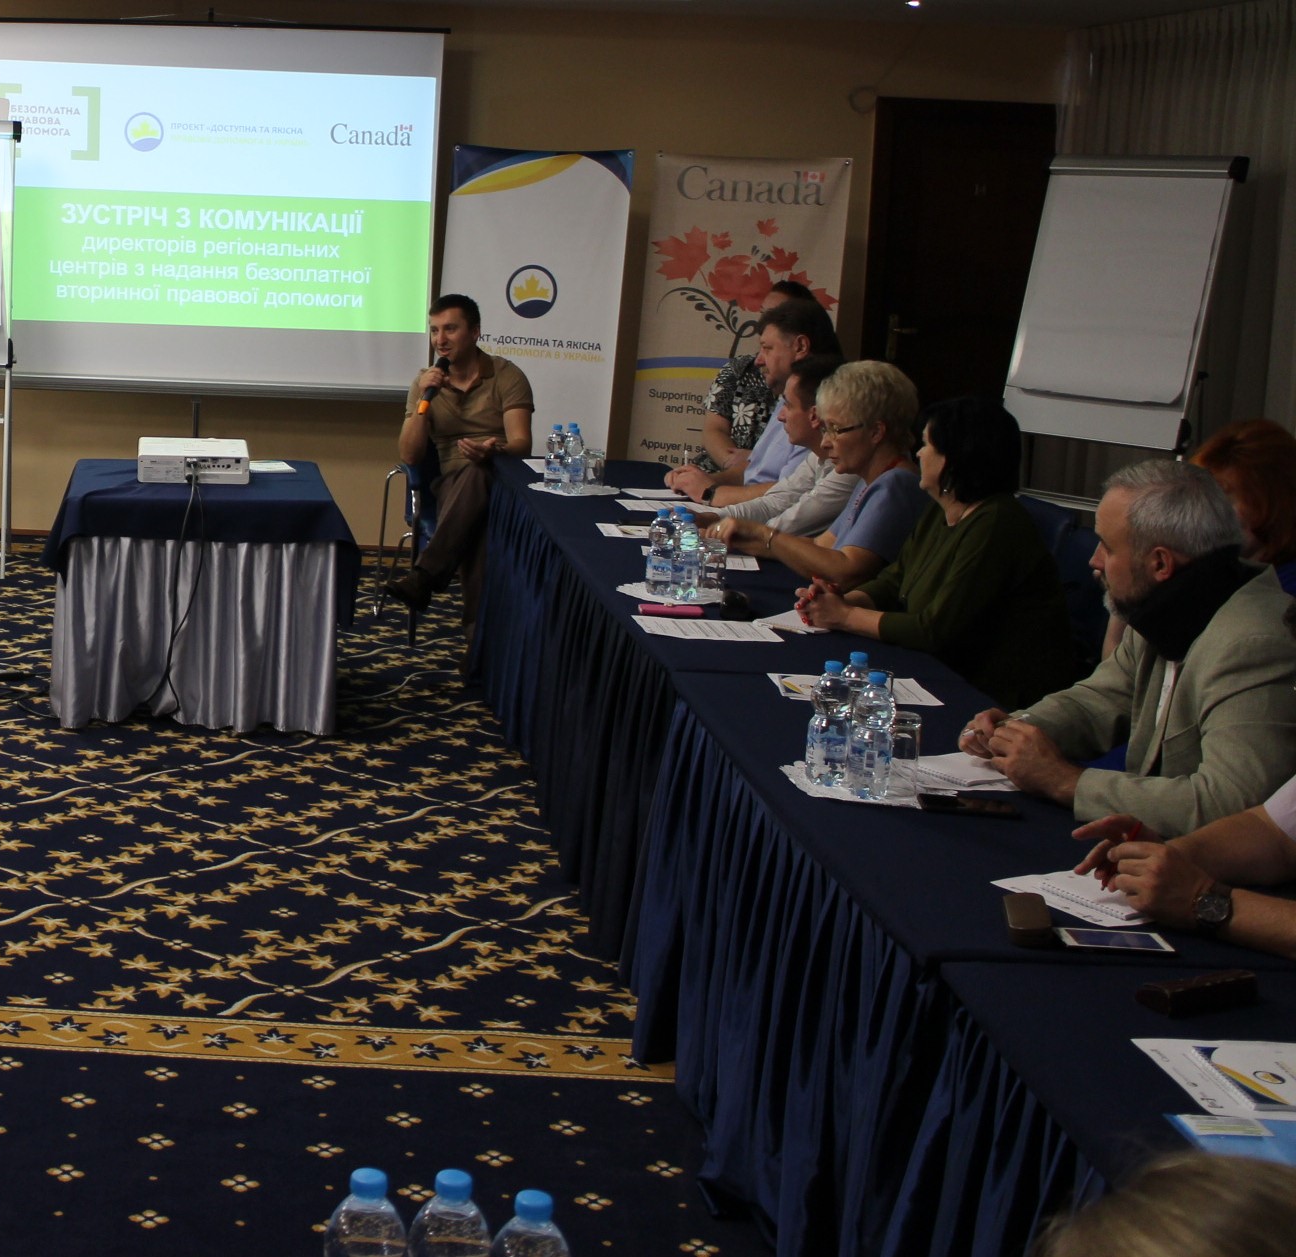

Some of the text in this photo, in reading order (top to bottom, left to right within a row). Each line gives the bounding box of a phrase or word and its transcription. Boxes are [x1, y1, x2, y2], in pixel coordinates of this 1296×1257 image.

[10, 104, 81, 116] БЕЗОПЛАТНА
[330, 123, 412, 146] Canada
[677, 165, 825, 206] Canada
[61, 202, 364, 237] ЗУСТРІЧ З КОМУНІКАЦІЇ
[81, 235, 340, 259] директорів регіональних
[49, 258, 372, 285] центрів з надання безоплатної
[56, 283, 363, 309] вторинної правової допомоги
[495, 346, 552, 359] ДОПОМОГА
[552, 339, 564, 348] ТА
[566, 340, 601, 351] ЯКІСНА
[649, 389, 703, 404] Supporting
[665, 405, 683, 413] and
[640, 439, 681, 451] Appuyer
[684, 443, 692, 452] la
[658, 454, 668, 463] et
[671, 455, 679, 464] la
